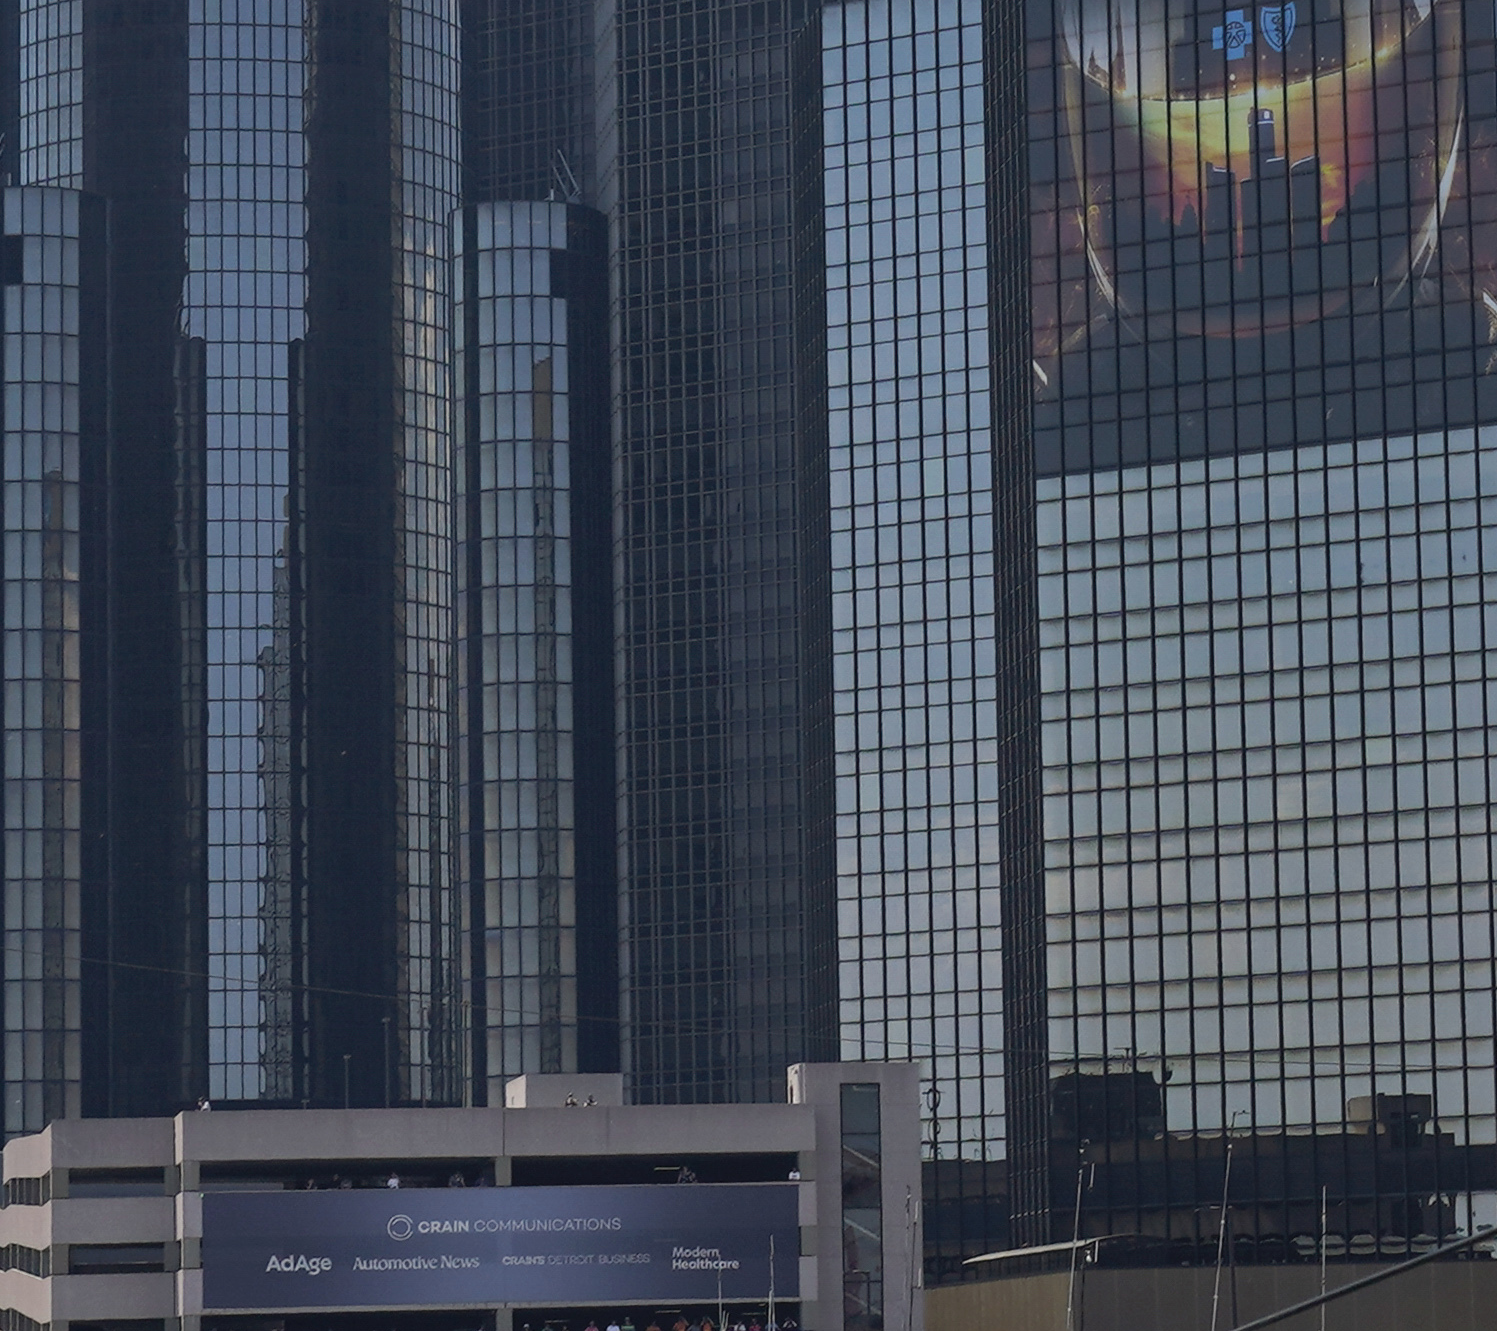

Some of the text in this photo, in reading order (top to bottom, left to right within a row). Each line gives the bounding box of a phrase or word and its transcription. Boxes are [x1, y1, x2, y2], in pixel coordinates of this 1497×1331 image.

[418, 1217, 622, 1233] CRAIN COMMUNICATIONS
[547, 1254, 594, 1265] DETROIT
[598, 1253, 651, 1264] BUSINESS
[672, 1247, 721, 1258] Modern
[265, 1254, 332, 1275] AdAge
[353, 1255, 480, 1271] Automotive News
[672, 1258, 740, 1270] Healthcare
